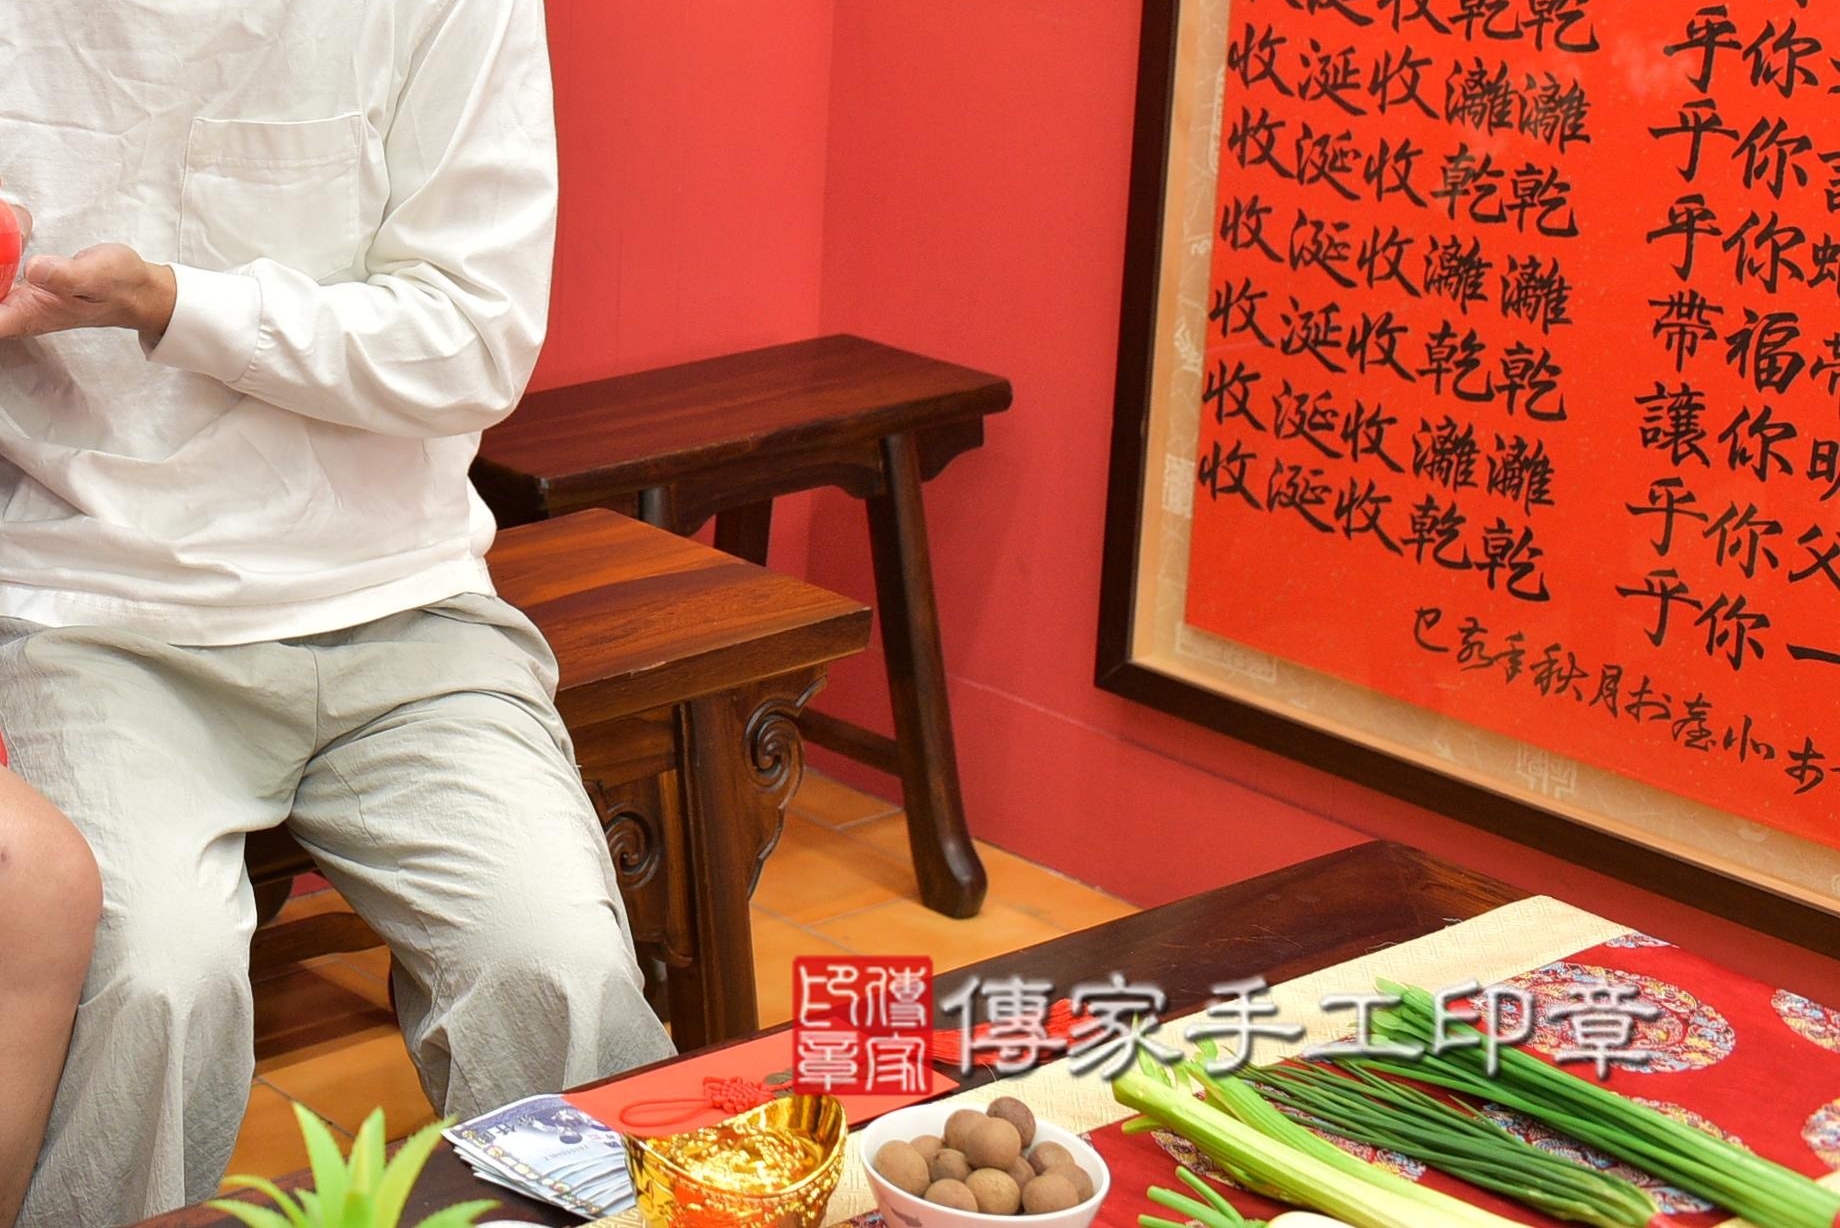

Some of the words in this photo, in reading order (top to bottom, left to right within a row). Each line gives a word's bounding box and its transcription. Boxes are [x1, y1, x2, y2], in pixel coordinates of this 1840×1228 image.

[1663, 4, 1840, 99] 乎你
[1228, 108, 1579, 237] 收涎收乾乾
[1648, 98, 1840, 200] 乎你
[1208, 278, 1567, 421] 收涎收乾乾
[1197, 440, 1551, 602] 收涎收乾乾
